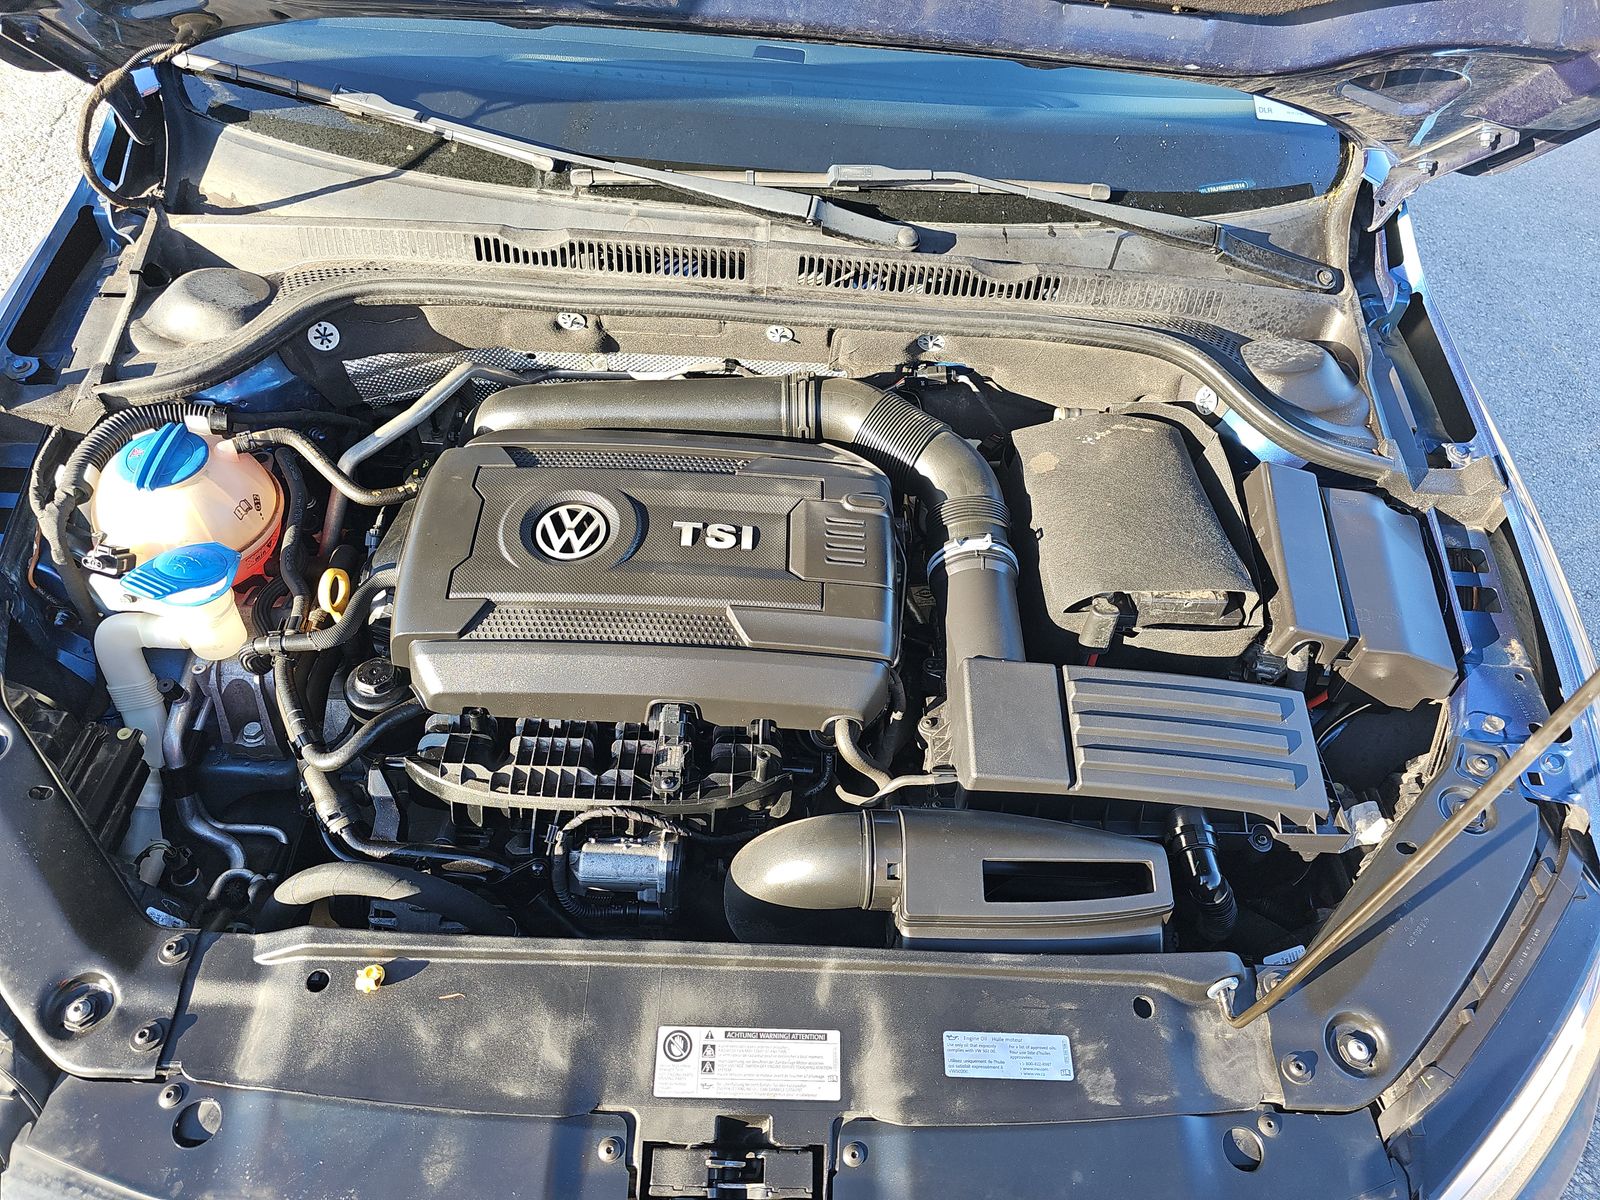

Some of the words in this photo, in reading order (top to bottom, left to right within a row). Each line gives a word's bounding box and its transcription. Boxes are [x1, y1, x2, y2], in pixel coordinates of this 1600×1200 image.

[535, 504, 606, 560] VW
[672, 520, 754, 551] TSI
[726, 1031, 759, 1039] ACHTUNG!
[759, 1032, 791, 1040] WARNING!
[791, 1033, 826, 1041] ATTENTION!
